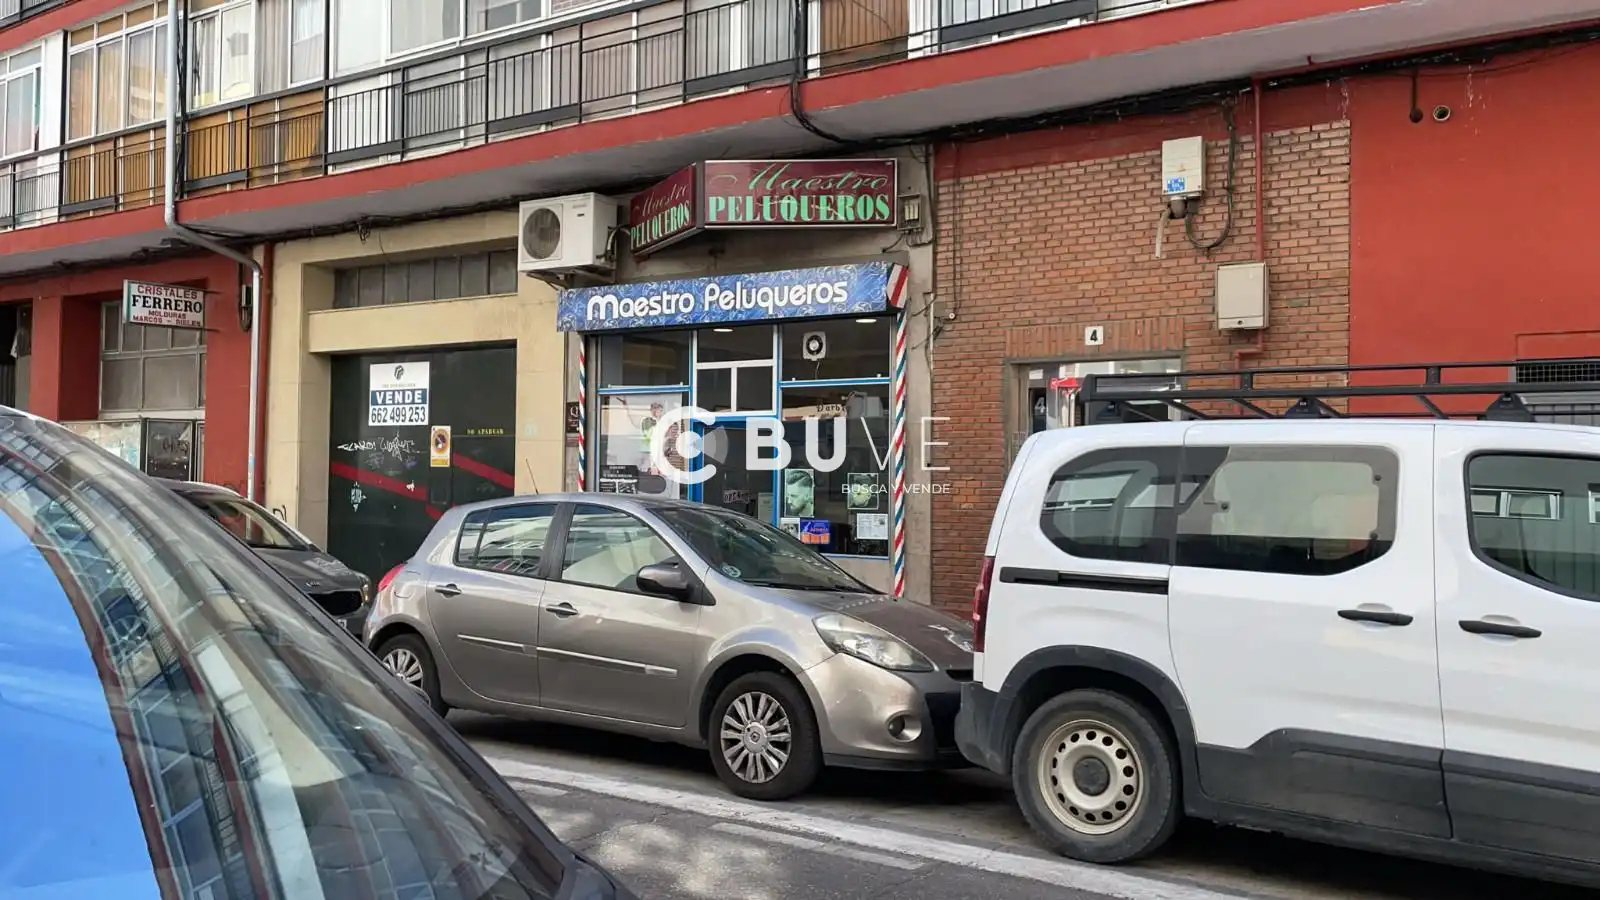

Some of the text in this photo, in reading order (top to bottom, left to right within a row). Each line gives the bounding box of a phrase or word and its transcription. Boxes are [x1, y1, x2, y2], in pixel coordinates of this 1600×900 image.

[745, 162, 889, 190] Maestro
[708, 194, 889, 222] PELUQUEROS
[137, 285, 198, 300] CRISTALES
[132, 295, 202, 313] FERRERO
[587, 281, 848, 321] Maestro Peluqueros
[133, 315, 163, 323] MARCOS
[148, 310, 187, 319] MOLDURAS
[1090, 329, 1098, 342] 4
[375, 390, 423, 404] VENDE
[371, 406, 426, 423] 662 499 253
